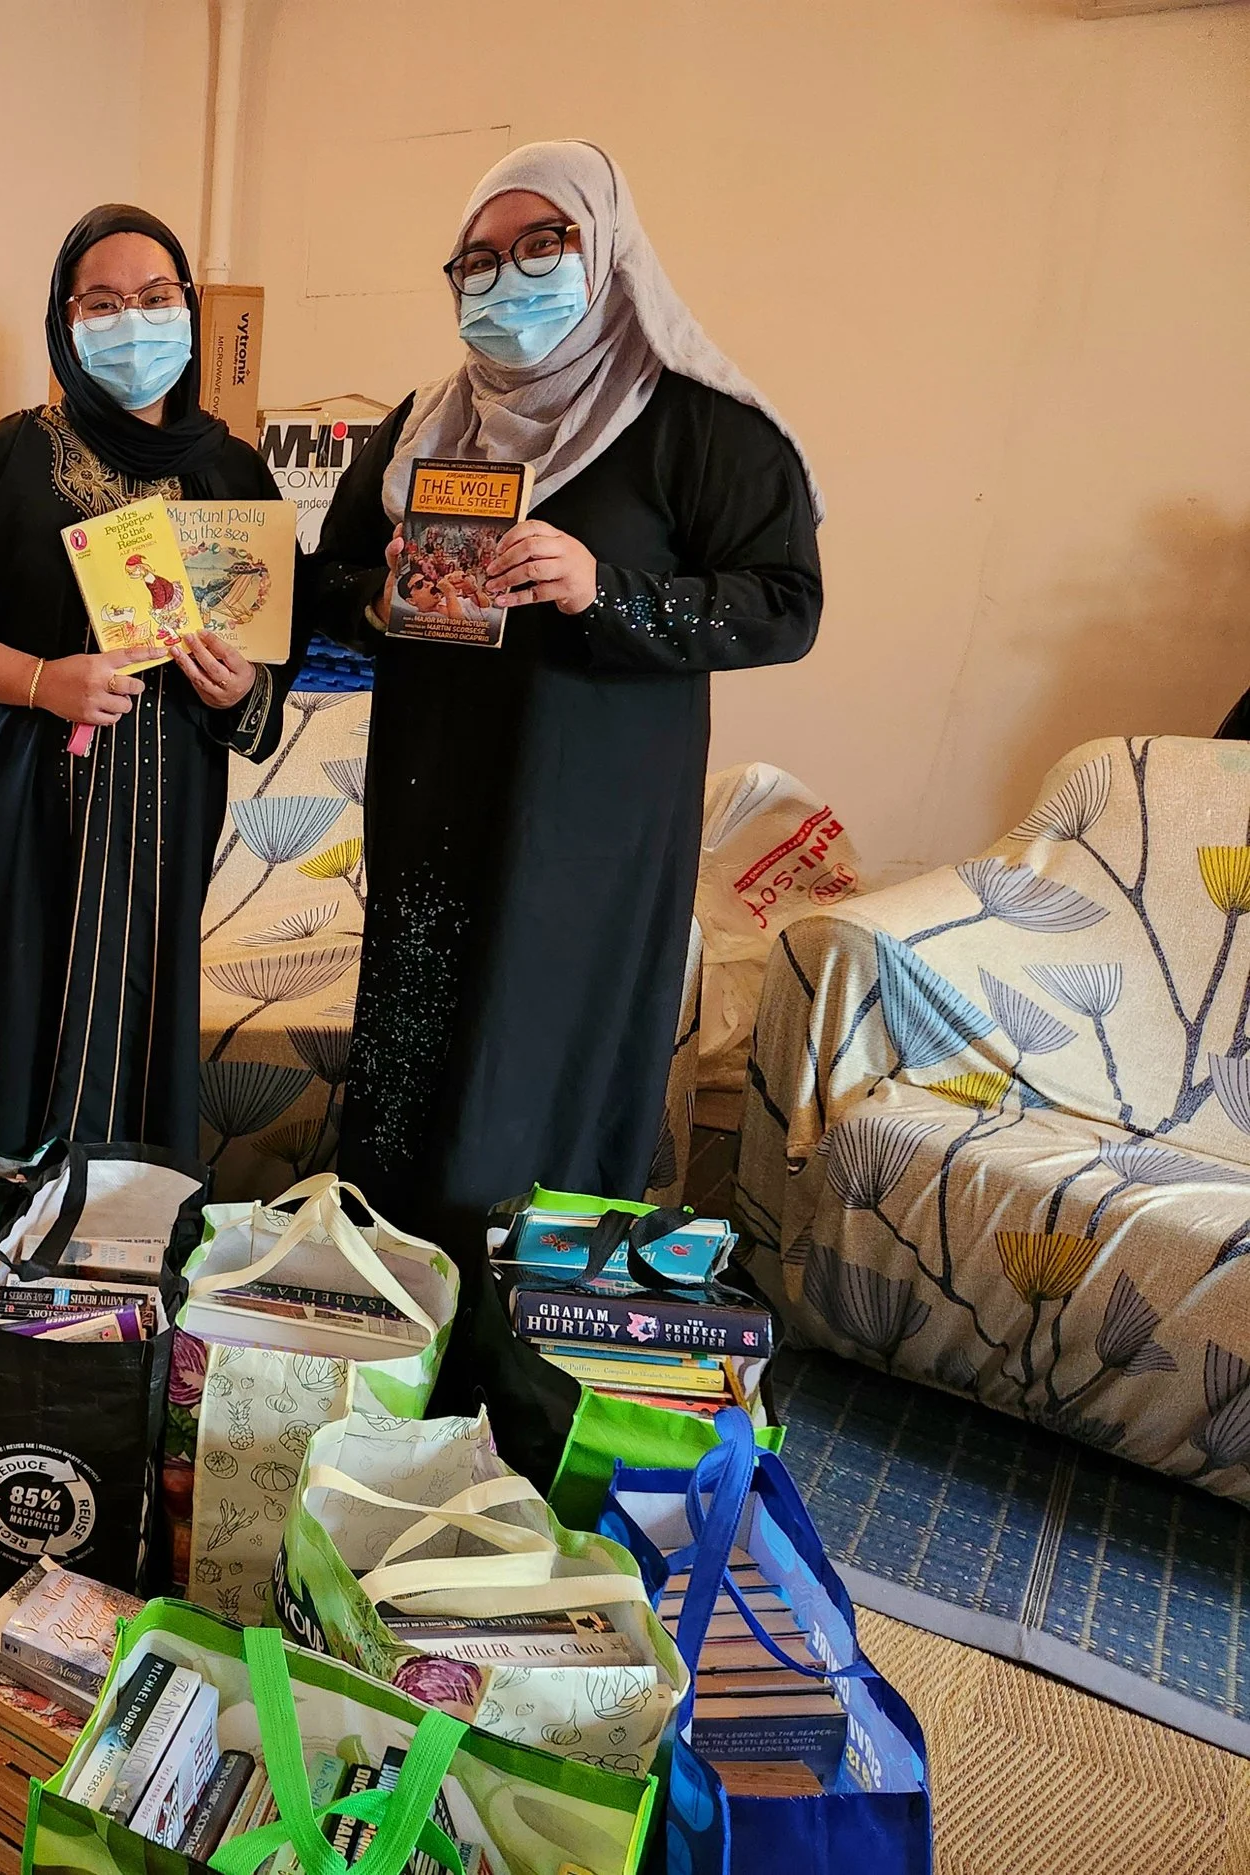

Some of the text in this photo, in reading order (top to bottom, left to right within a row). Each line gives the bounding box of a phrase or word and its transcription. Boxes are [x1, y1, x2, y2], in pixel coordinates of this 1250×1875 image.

[236, 312, 250, 385] vytronix
[215, 336, 224, 395] MICROWAVE
[422, 479, 511, 498] THE WOLF
[419, 495, 508, 508] OF WALL STREET
[104, 513, 154, 535] Pepperpot
[116, 511, 137, 523] Mrs
[166, 508, 265, 526] My Aunt Polly
[130, 527, 145, 536] the
[180, 525, 249, 544] by the sea
[117, 533, 152, 550] Rescue
[70, 1294, 99, 1305] REICHS
[100, 1296, 124, 1306] KATHY
[277, 1283, 387, 1312] ISABELLA
[539, 1303, 609, 1322] GRAHAM
[527, 1315, 622, 1339] HURLEY
[664, 1323, 727, 1339] PERFECT
[665, 1333, 726, 1347] SOLDIER
[10, 1486, 61, 1511] 85%
[9, 1514, 60, 1531] MATERIALS
[10, 1505, 60, 1523] RECYCLED
[71, 1499, 90, 1540] REUSE
[454, 1643, 604, 1658] HELLER The Club
[172, 1678, 190, 1697] The
[117, 1662, 164, 1737] MICHAEL DOBBS
[88, 1747, 118, 1793] WHISPERS
[351, 1769, 371, 1792] DIC
